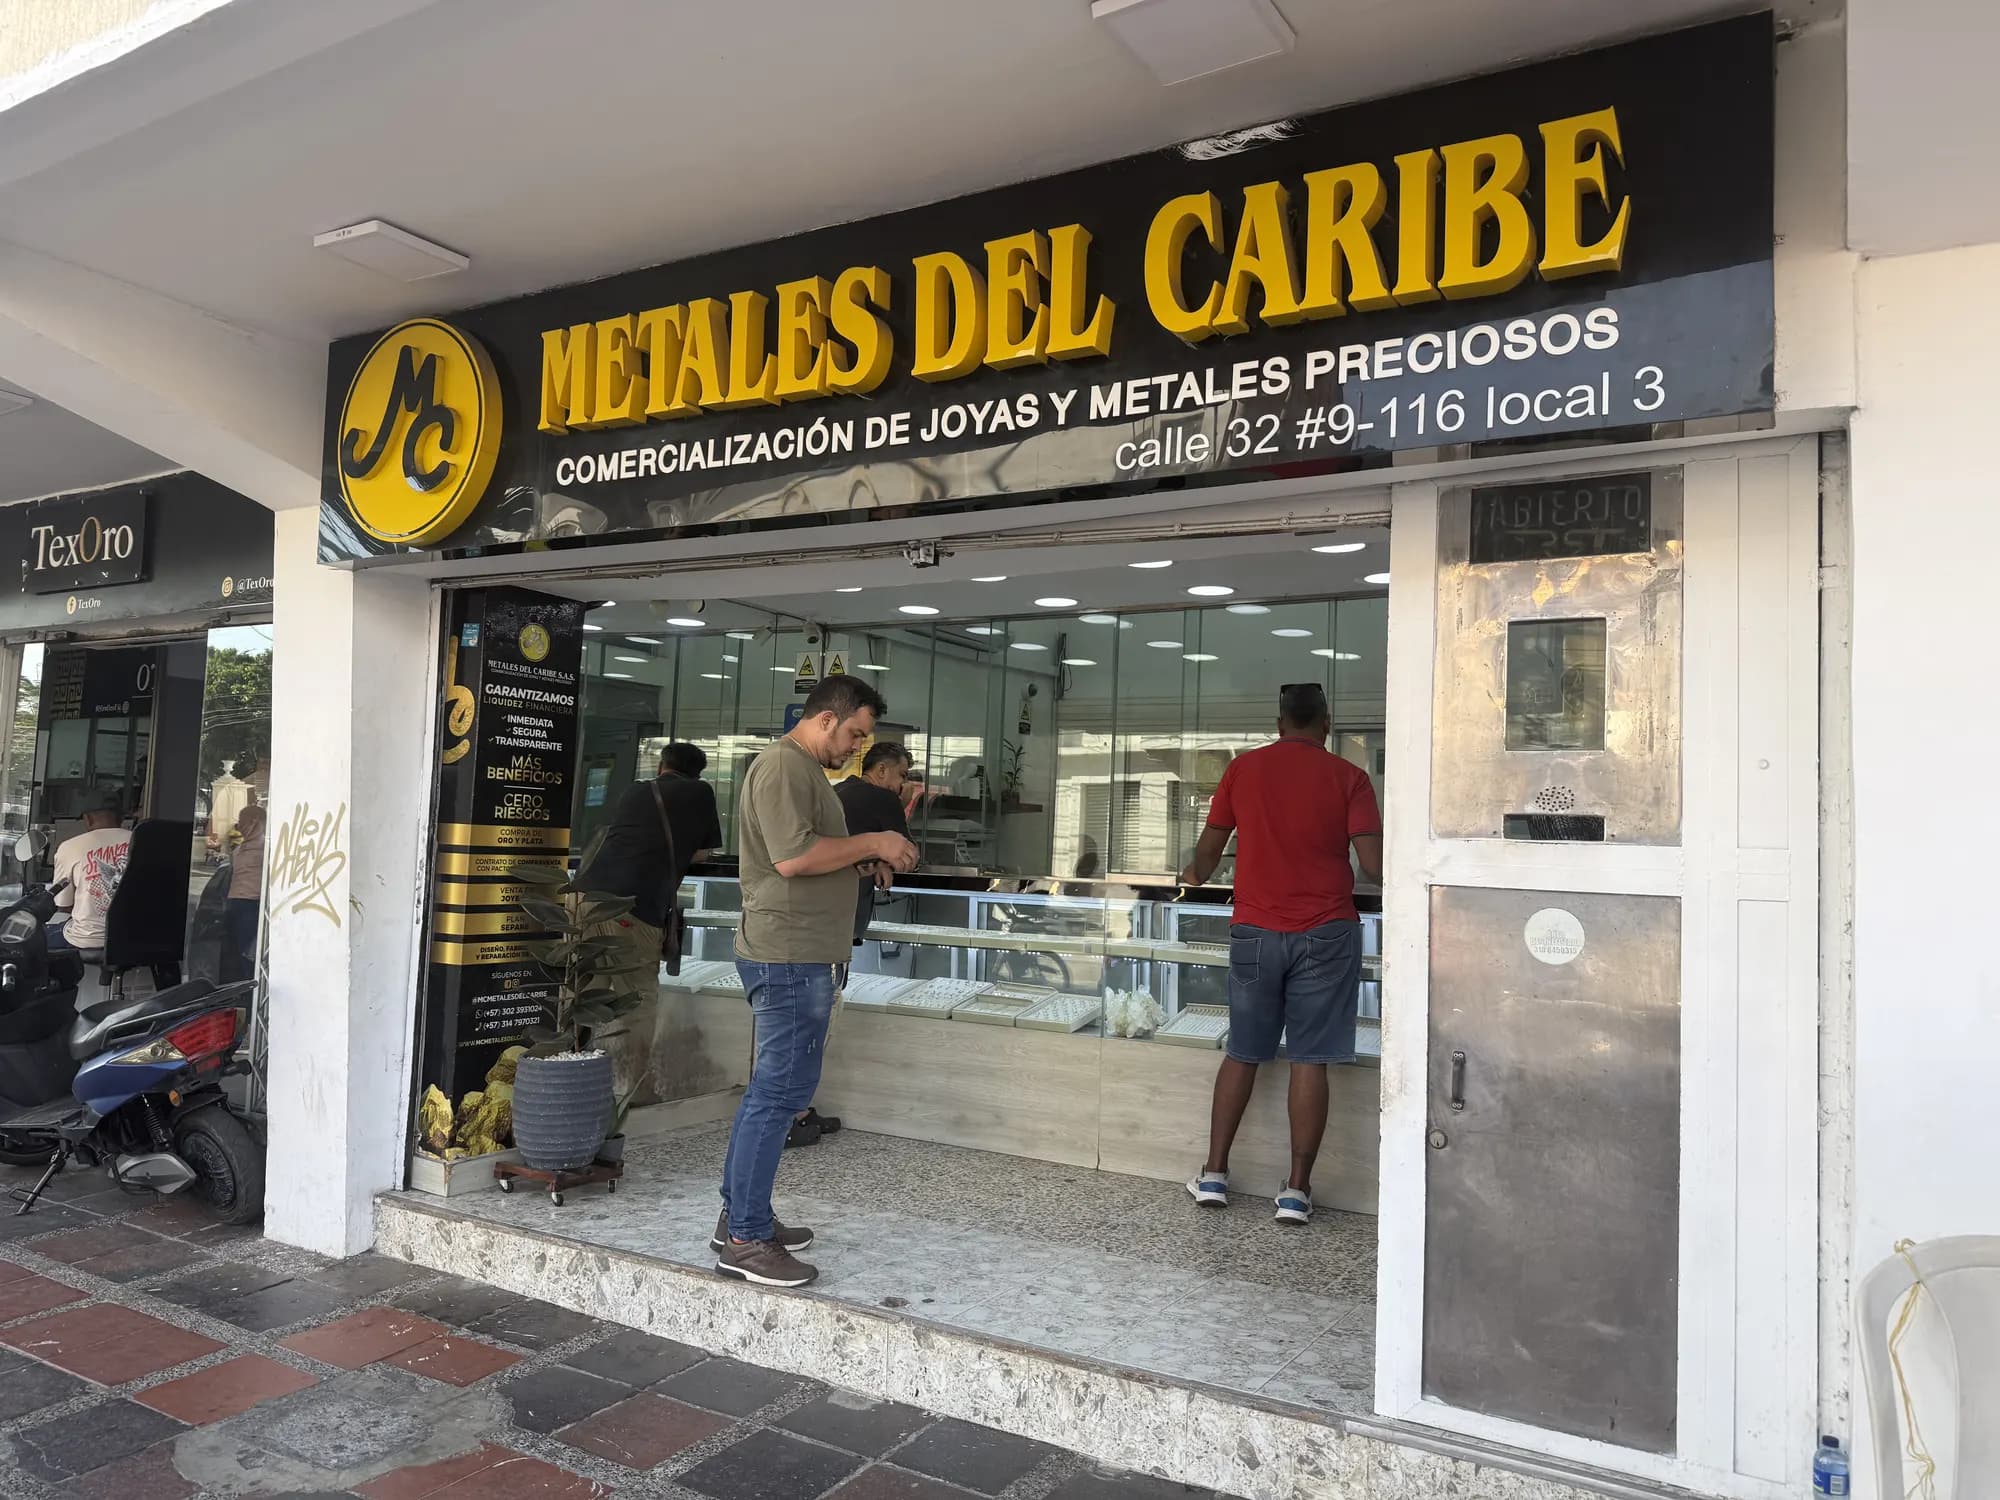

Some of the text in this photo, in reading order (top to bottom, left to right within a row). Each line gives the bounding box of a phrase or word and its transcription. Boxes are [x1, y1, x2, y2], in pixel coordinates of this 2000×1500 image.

[537, 106, 1631, 434] METALES DEL CARIBE
[555, 307, 1620, 486] COMERCIALIZACIÓN DE JOYAS Y METALES PRECIOSOS
[1115, 366, 1666, 471] calle 32 #9-116 local 3
[1489, 485, 1642, 529] ABIERTO
[31, 516, 134, 571] TexOro
[78, 597, 101, 610] TexOro
[488, 660, 519, 671] METALES
[520, 666, 532, 674] DEL
[533, 668, 557, 678] CARIBE
[485, 683, 575, 706] GARANTIZAMOS
[483, 696, 574, 715] LIQUIDEZ FINANCIERA
[507, 714, 553, 728] INMEDIATA
[512, 727, 547, 738] SEGURA
[495, 736, 562, 751] TRANSPARENTE
[511, 753, 541, 770] MÁS
[487, 766, 563, 784] BENEFICIOS
[503, 793, 543, 808] CERO
[494, 806, 550, 821] RIESGOS
[500, 828, 531, 837] COMPRA
